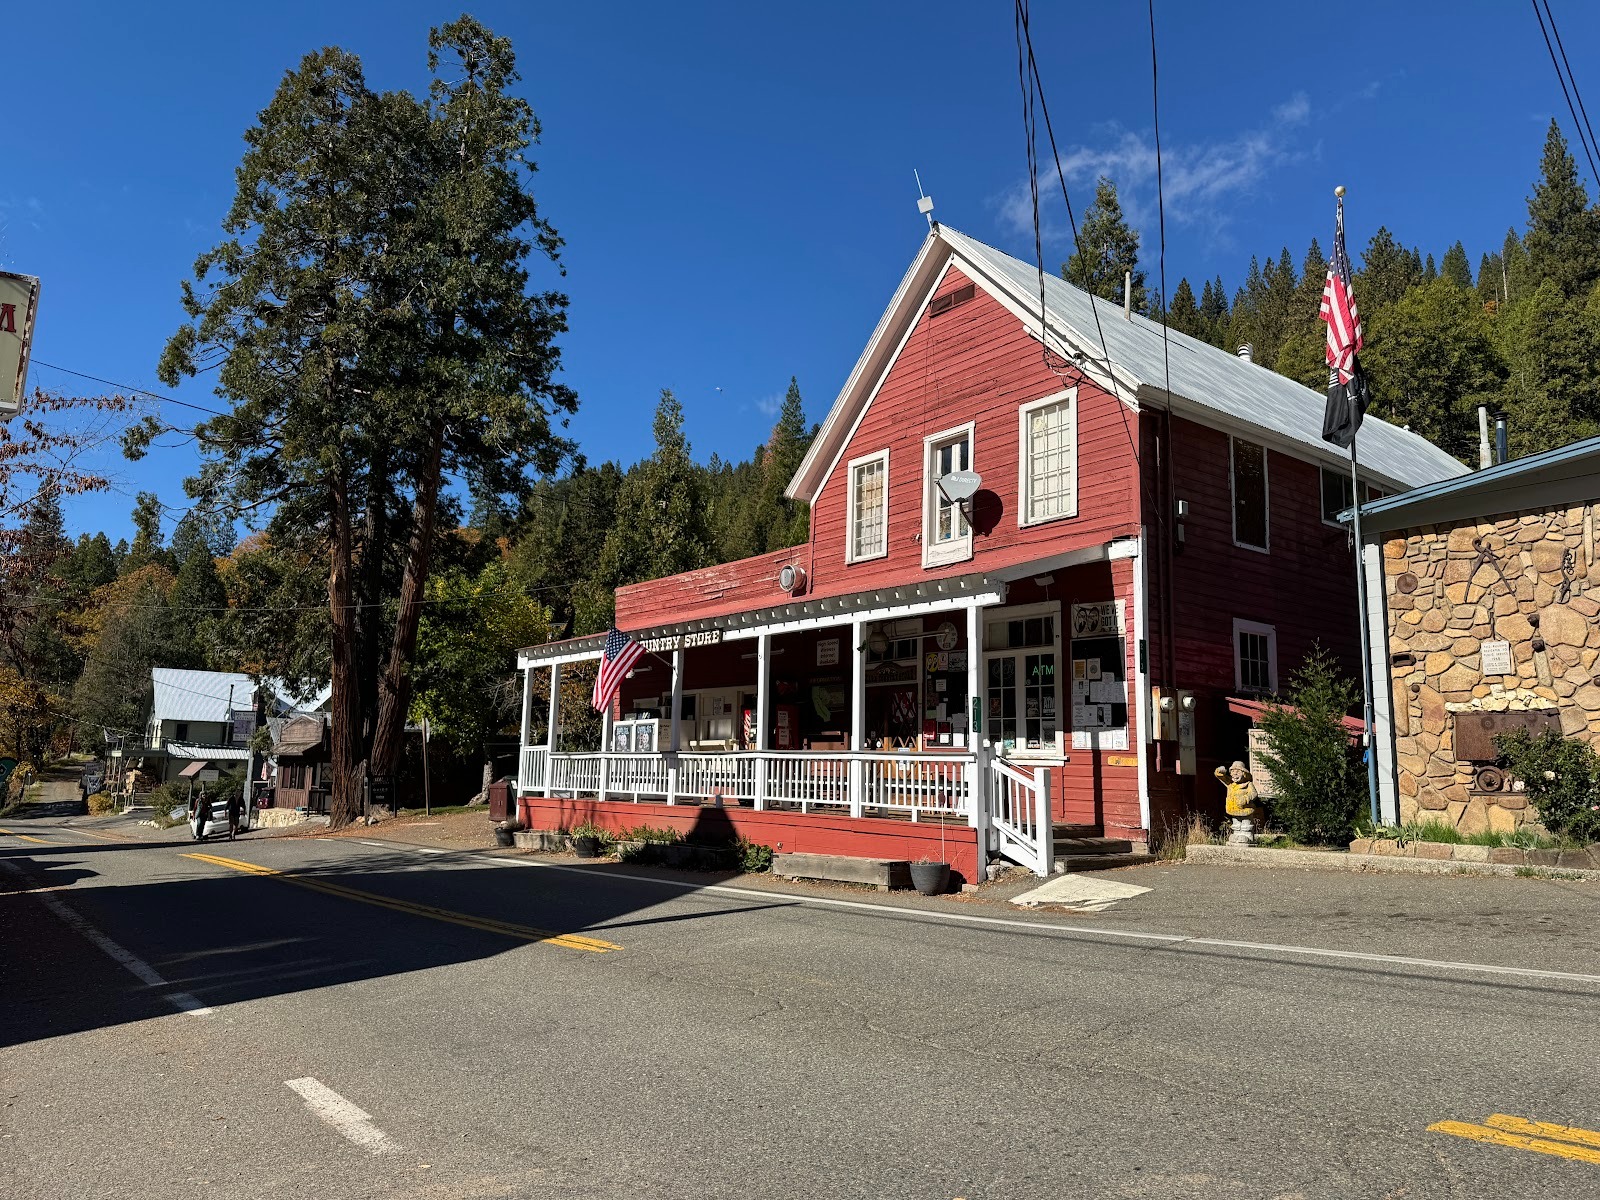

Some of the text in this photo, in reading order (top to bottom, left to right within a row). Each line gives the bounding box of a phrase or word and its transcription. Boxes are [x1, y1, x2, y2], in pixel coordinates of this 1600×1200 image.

[638, 630, 720, 653] OUNTRY STORE
[1032, 664, 1054, 676] ATM
